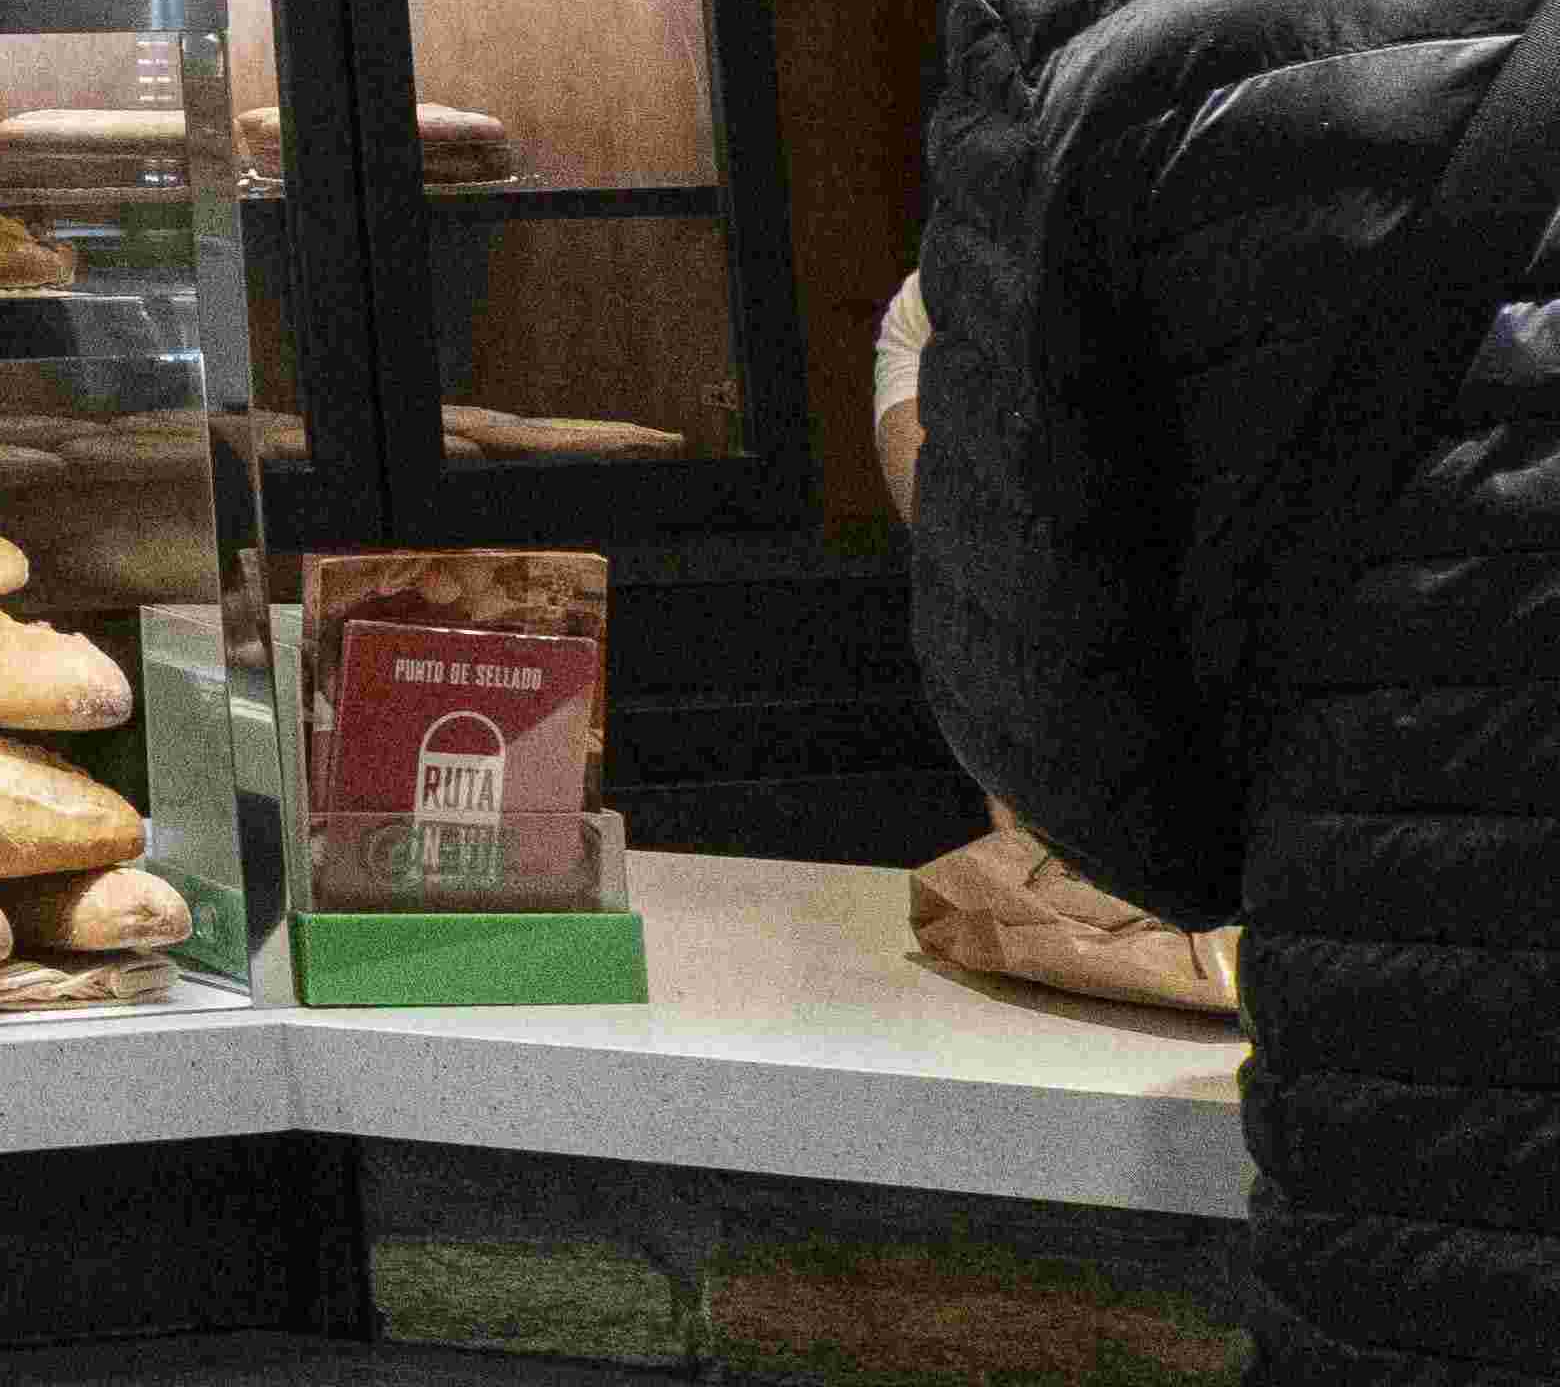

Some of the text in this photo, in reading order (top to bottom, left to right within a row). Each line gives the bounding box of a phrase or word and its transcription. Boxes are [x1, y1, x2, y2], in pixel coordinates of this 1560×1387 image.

[393, 658, 544, 692] PUNTO DE SELLADO
[423, 765, 494, 812] RUTA
